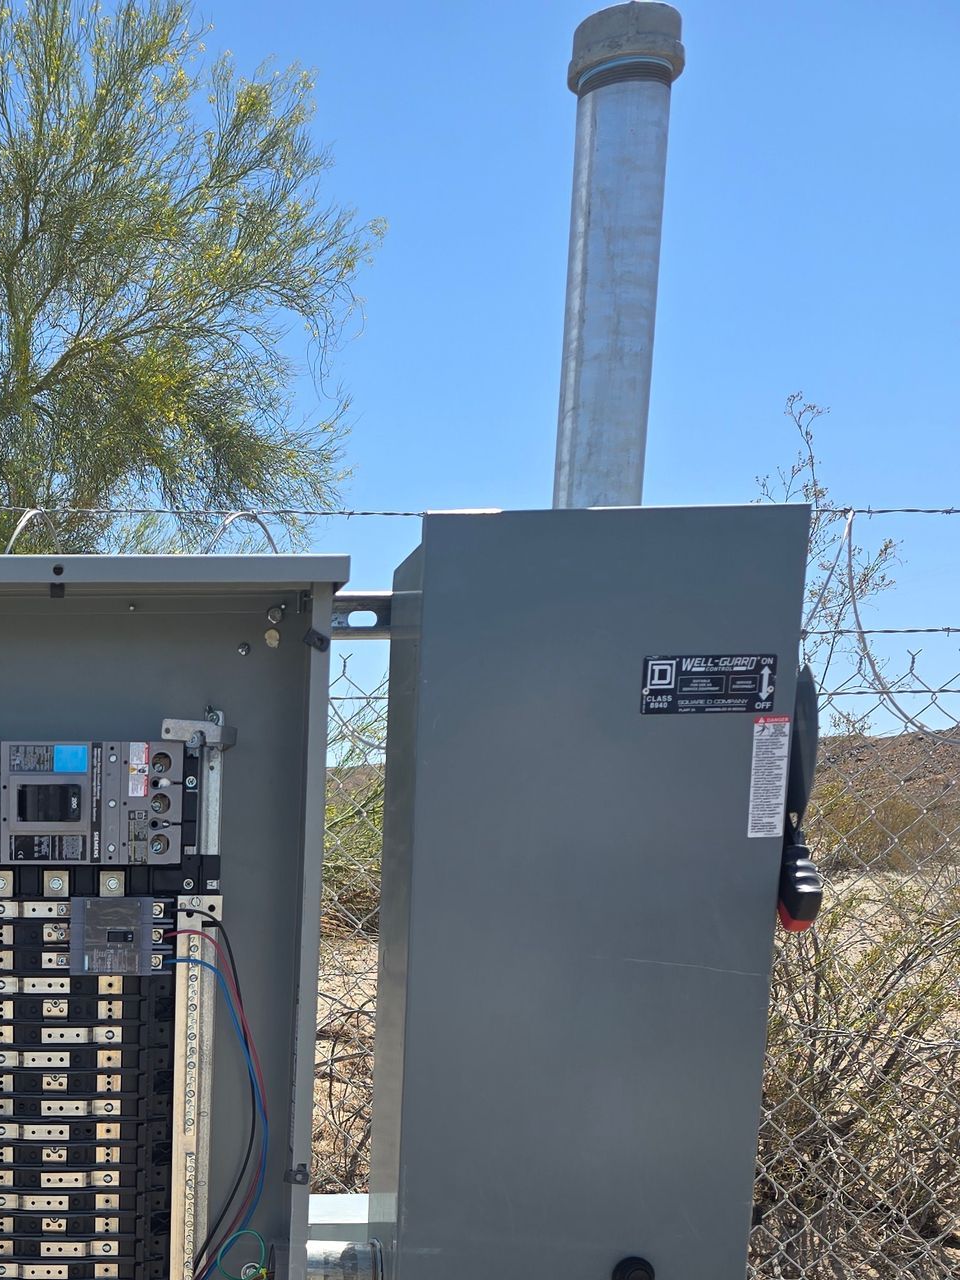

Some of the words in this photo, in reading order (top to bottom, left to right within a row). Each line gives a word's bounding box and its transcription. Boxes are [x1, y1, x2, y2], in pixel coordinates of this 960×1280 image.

[681, 656, 757, 672] WELL-GUARD
[761, 657, 773, 665] ON
[755, 701, 772, 709] OFF
